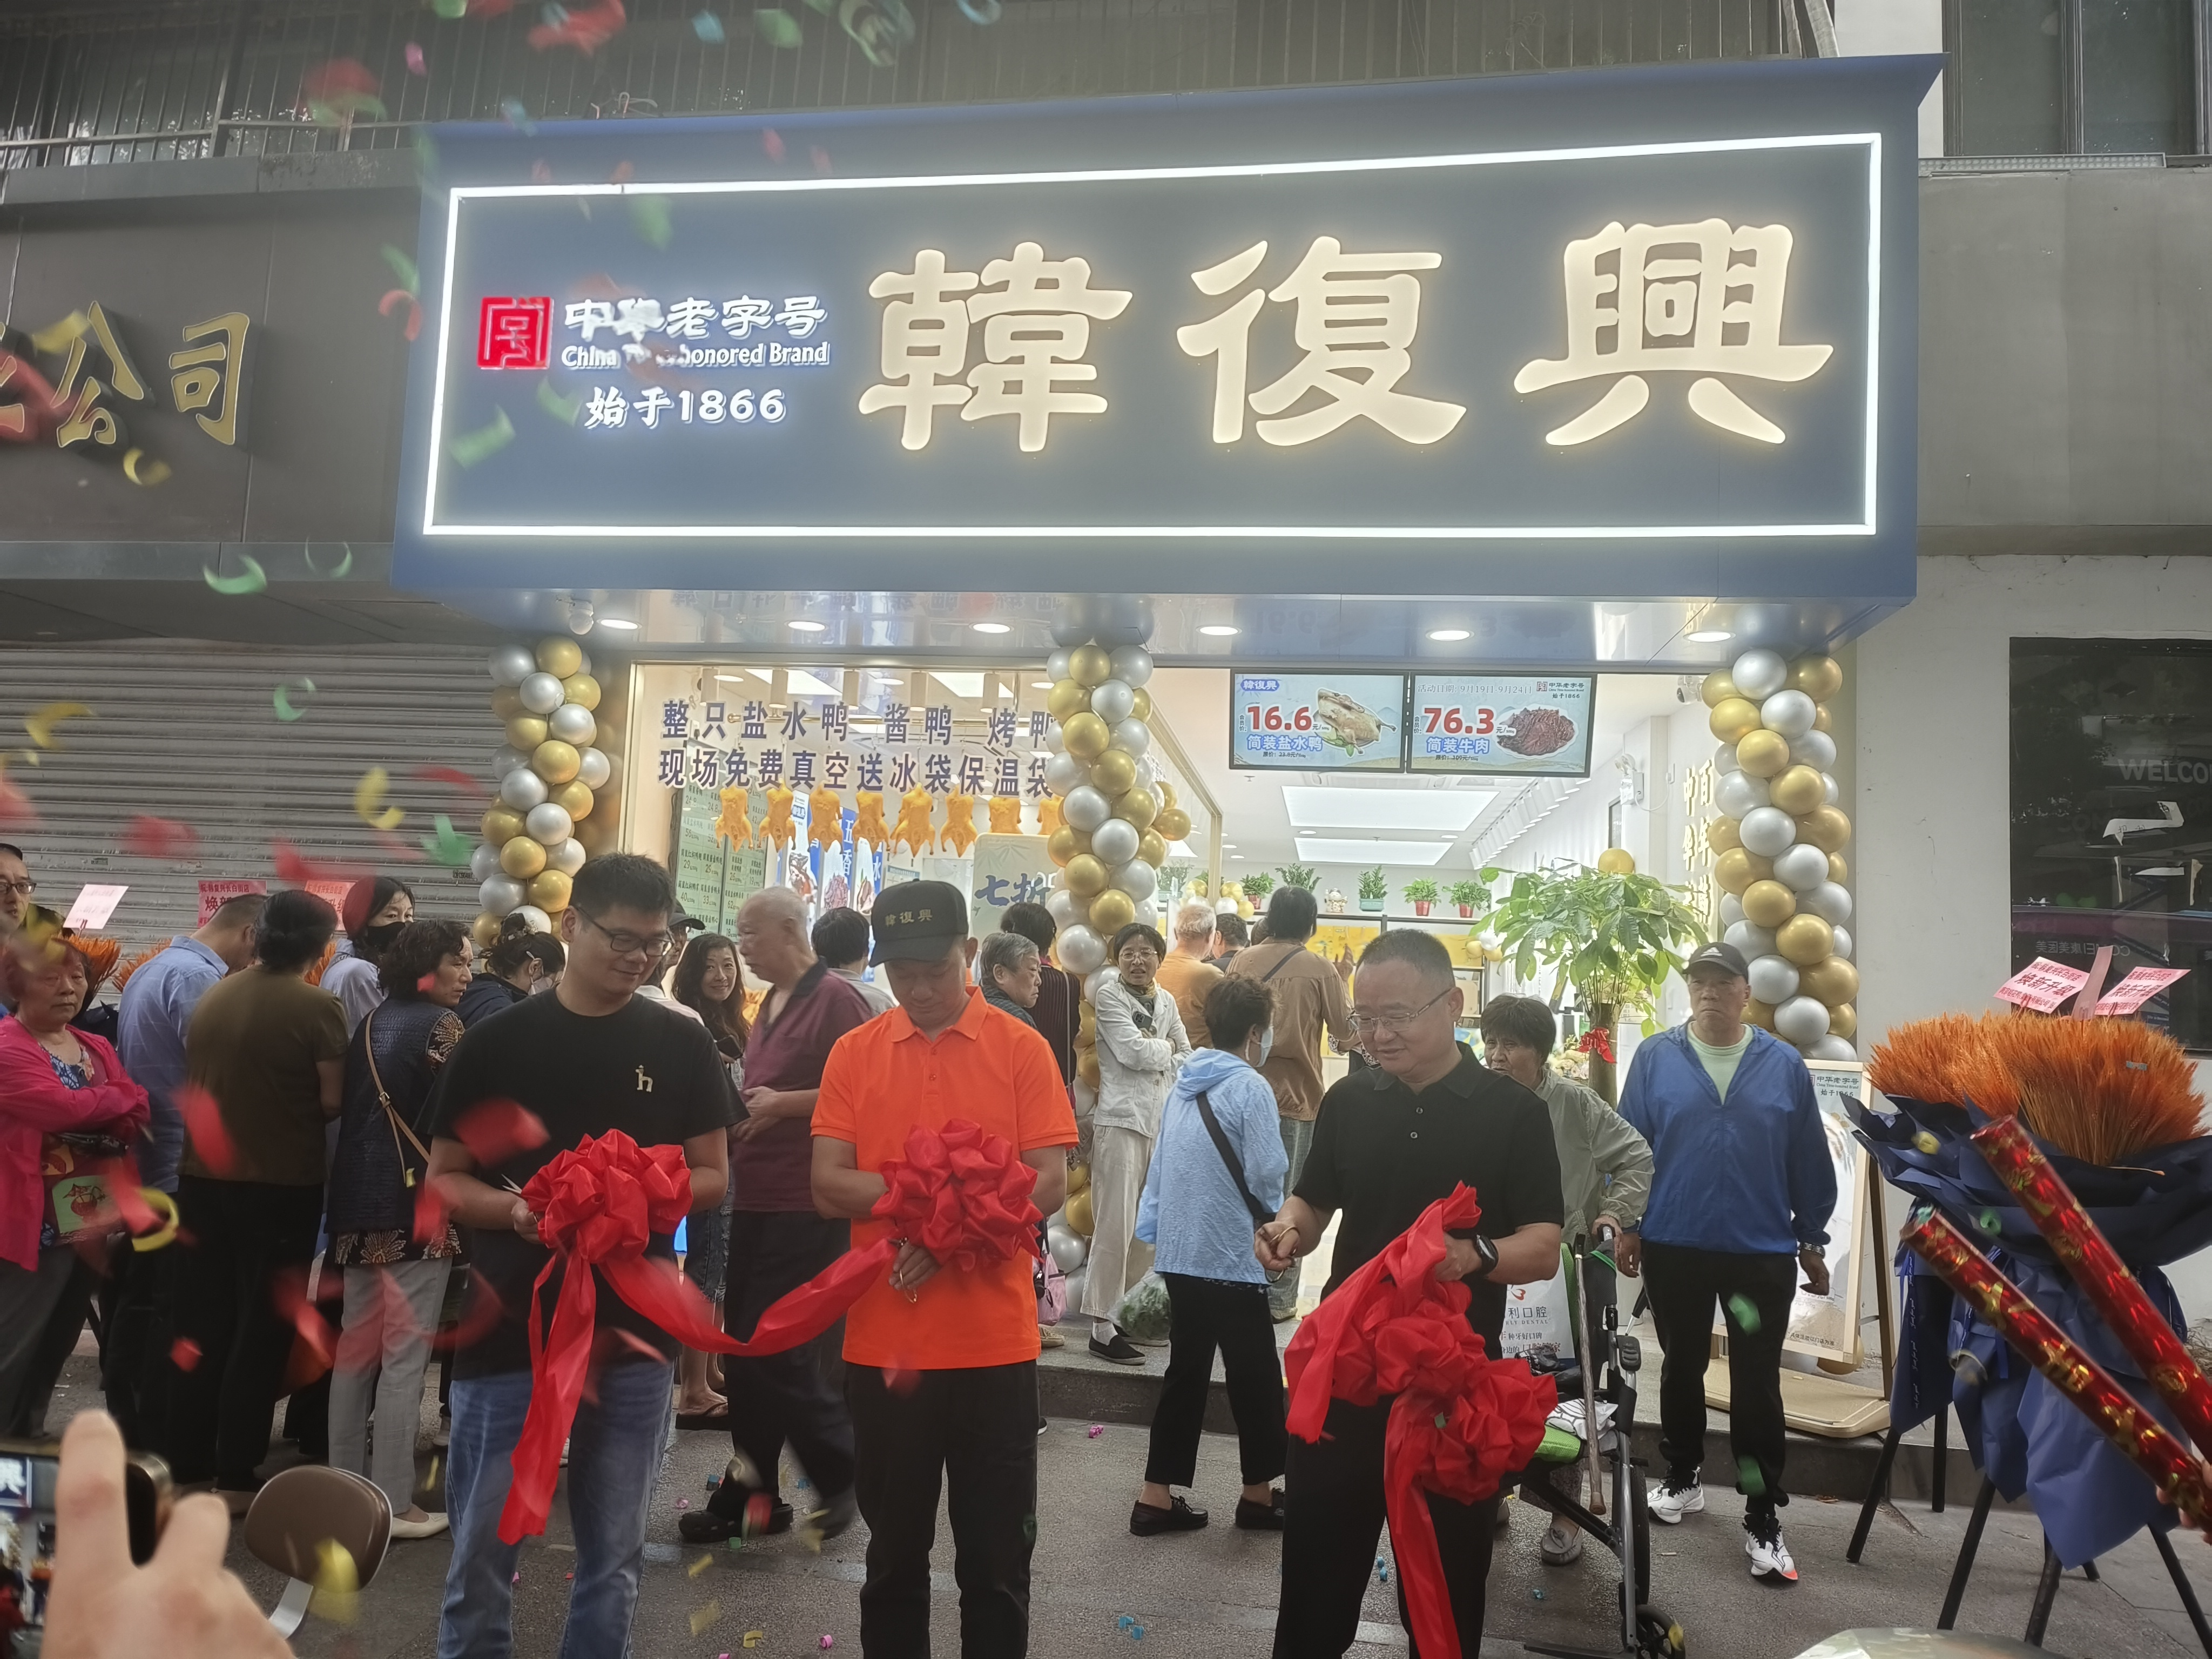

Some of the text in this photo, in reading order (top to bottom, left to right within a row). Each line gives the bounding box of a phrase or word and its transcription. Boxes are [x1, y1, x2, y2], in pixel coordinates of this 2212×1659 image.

[859, 219, 1833, 451] 韓復興
[561, 341, 830, 369] China honored Brand
[0, 300, 249, 448] 公司
[584, 386, 786, 429] 始于1866
[663, 700, 849, 741] 整只盐水鸭
[884, 703, 952, 745] 酱鸭
[1247, 706, 1312, 730] 16.6
[1424, 707, 1494, 734] 76.3
[1247, 735, 1323, 751] 简装盐水鸭
[1427, 737, 1489, 753] 简装牛肉
[658, 748, 1054, 798] 现场免费真空送冰袋保温袋
[2117, 759, 2212, 784] WELCO
[843, 819, 854, 875] 五香
[974, 873, 1051, 907] 七折
[2014, 973, 2076, 996] 焕新升级
[1817, 1076, 1859, 1084] 中华老字号
[1508, 1306, 1547, 1319] 利口腔
